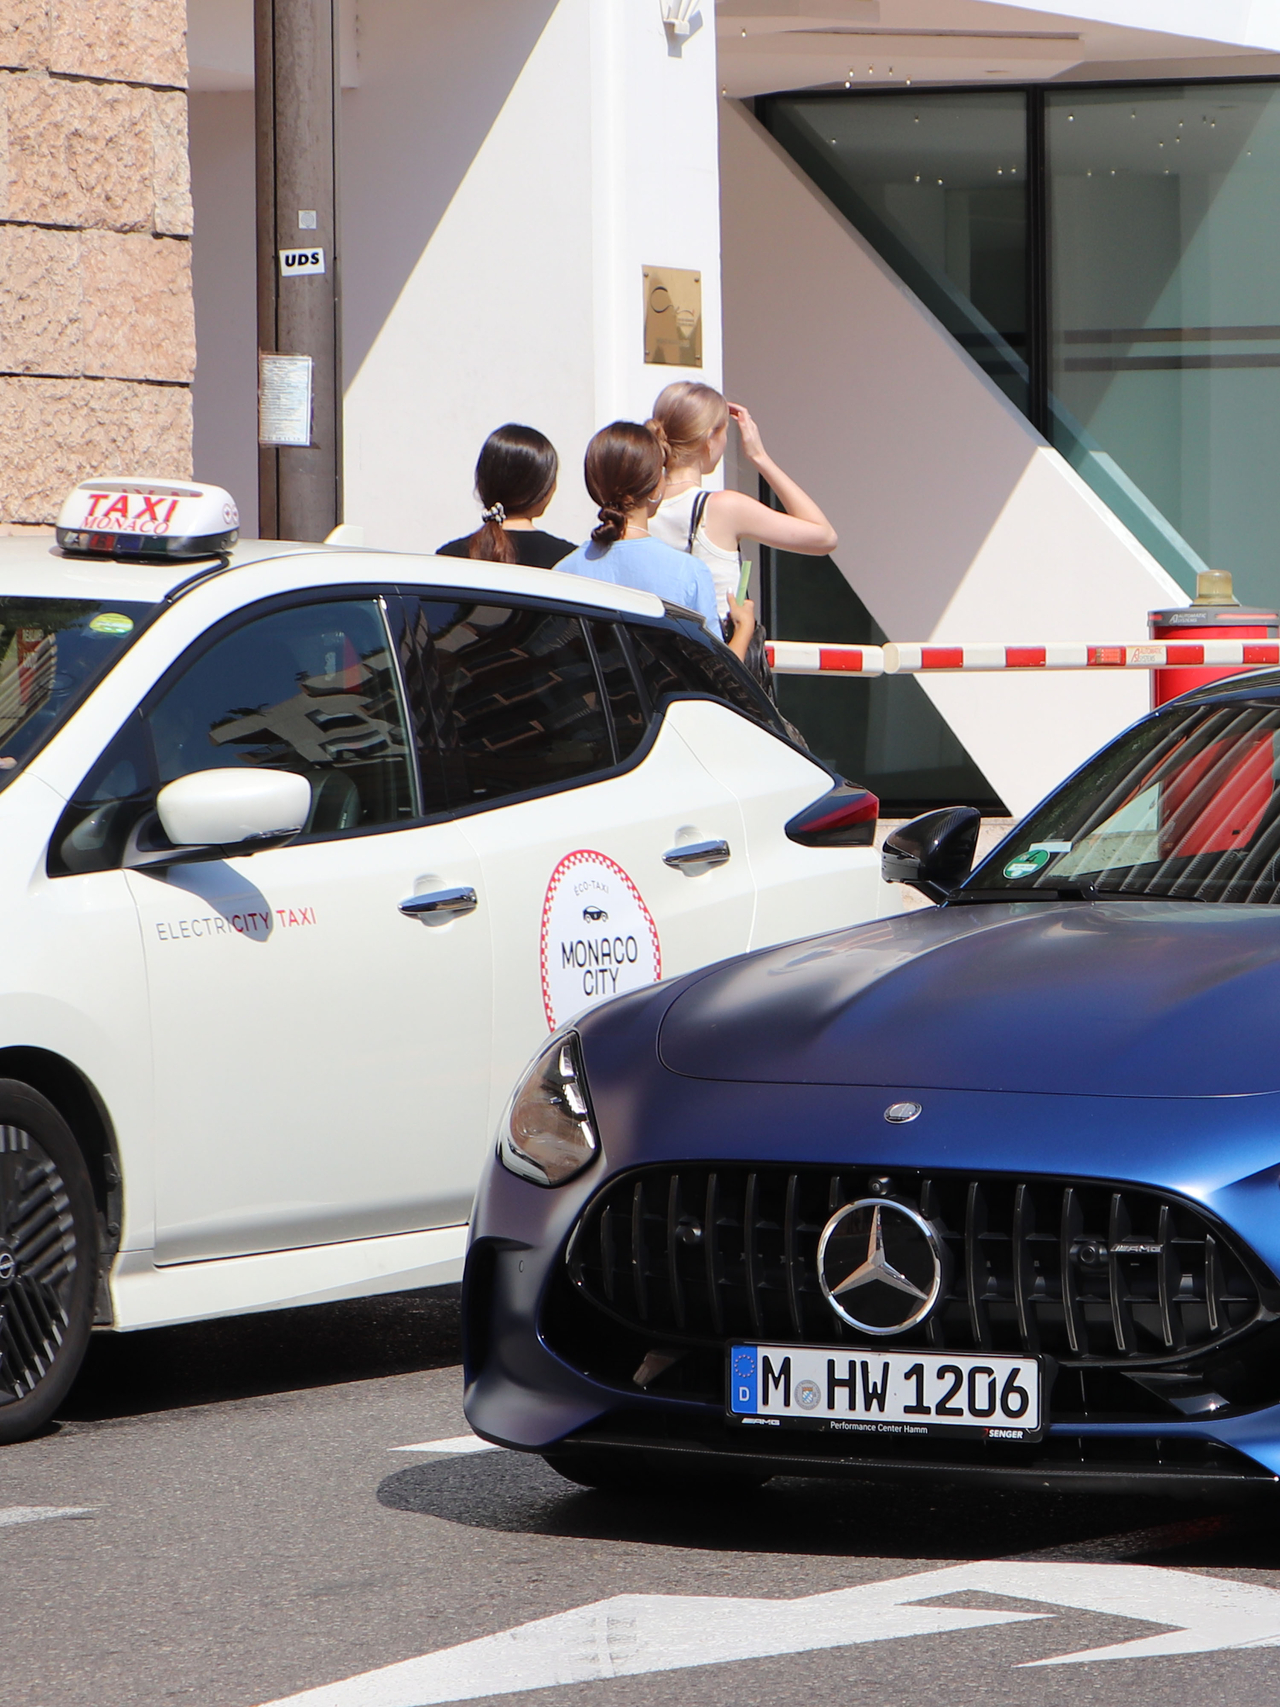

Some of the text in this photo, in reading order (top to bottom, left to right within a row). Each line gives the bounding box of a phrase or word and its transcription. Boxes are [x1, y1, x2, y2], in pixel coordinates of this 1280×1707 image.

[285, 252, 320, 267] UDS
[87, 494, 179, 523] TAXI
[79, 515, 169, 535] MONACO
[156, 907, 317, 941] ELECTRICITY TAXI
[561, 935, 638, 969] MONACO
[583, 967, 619, 996] CITY
[739, 1387, 749, 1402] D
[762, 1355, 1030, 1418] M HW 1206
[830, 1421, 928, 1434] Performance Center Hamm
[988, 1429, 1023, 1439] SENGER
